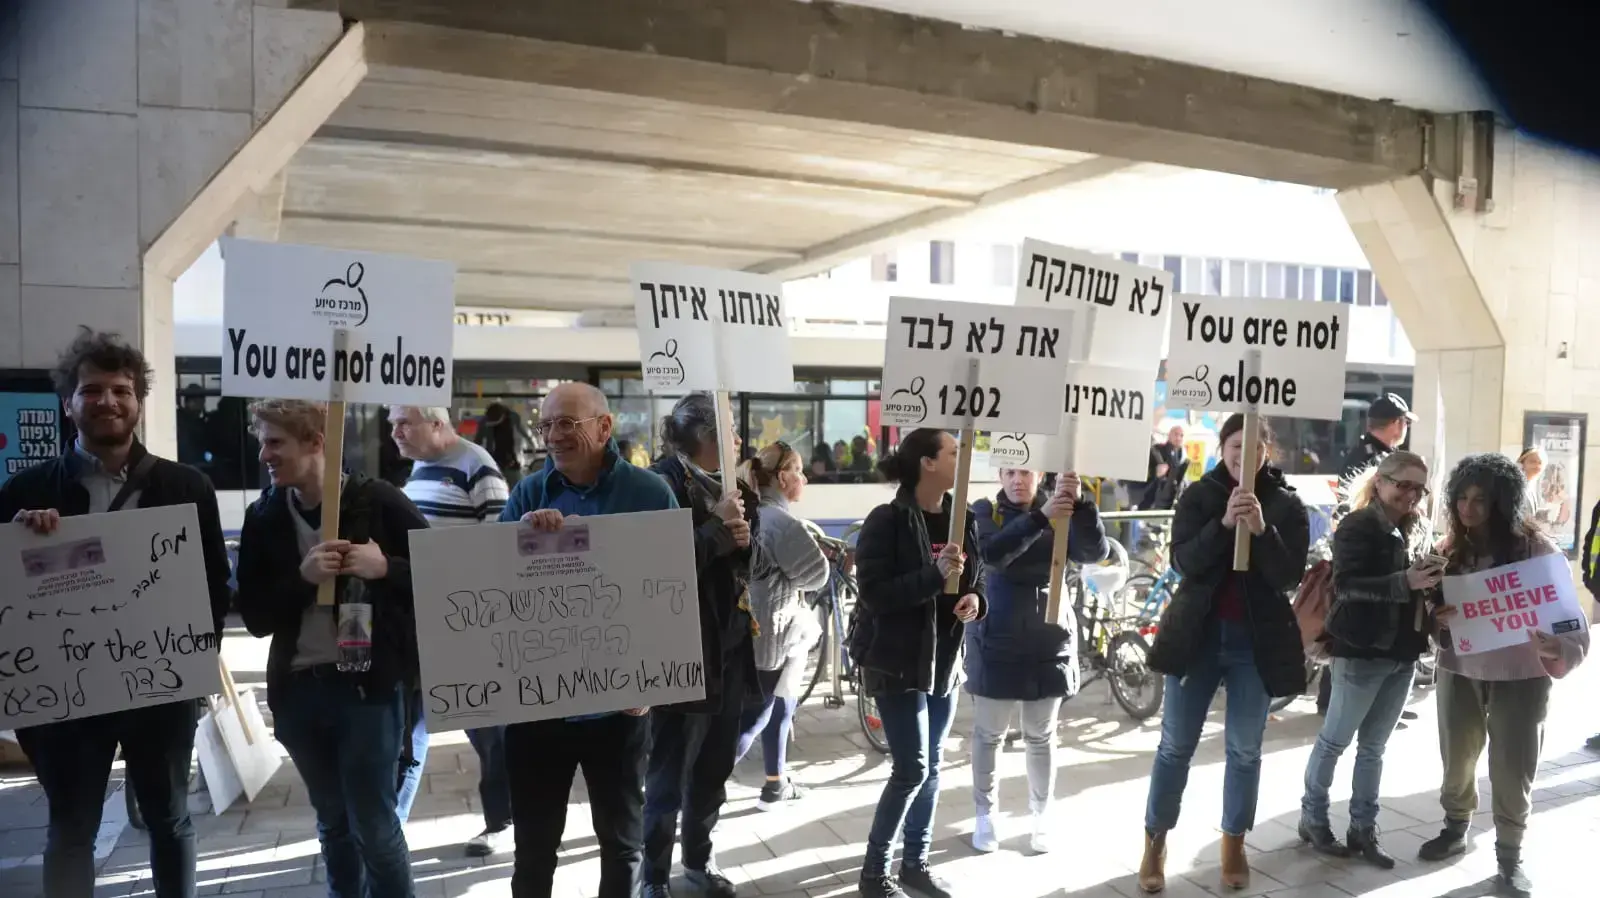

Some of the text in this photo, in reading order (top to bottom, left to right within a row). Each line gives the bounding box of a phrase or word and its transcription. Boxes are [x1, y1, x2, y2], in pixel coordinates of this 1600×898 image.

[1025, 252, 1164, 317] לא שותקת
[315, 297, 361, 311] מרכז סיוע
[639, 282, 782, 328] אנחנו איתך
[901, 312, 1059, 358] את לא לבד
[1183, 302, 1340, 350] You are not
[228, 328, 446, 388] You are not alone
[938, 384, 1001, 418] 1202
[1218, 360, 1297, 407] alone
[18, 409, 55, 424] עמדת
[886, 403, 922, 413] מרכז סיוע
[20, 425, 56, 440] ניפוח
[20, 440, 56, 457] גלגלי
[1484, 570, 1522, 594] WE
[1461, 584, 1560, 620] BELIEVE
[1490, 610, 1539, 633] YOU
[59, 628, 96, 663] for
[104, 628, 149, 663] the
[428, 659, 704, 715] STOP BLAMING the VICTIM
